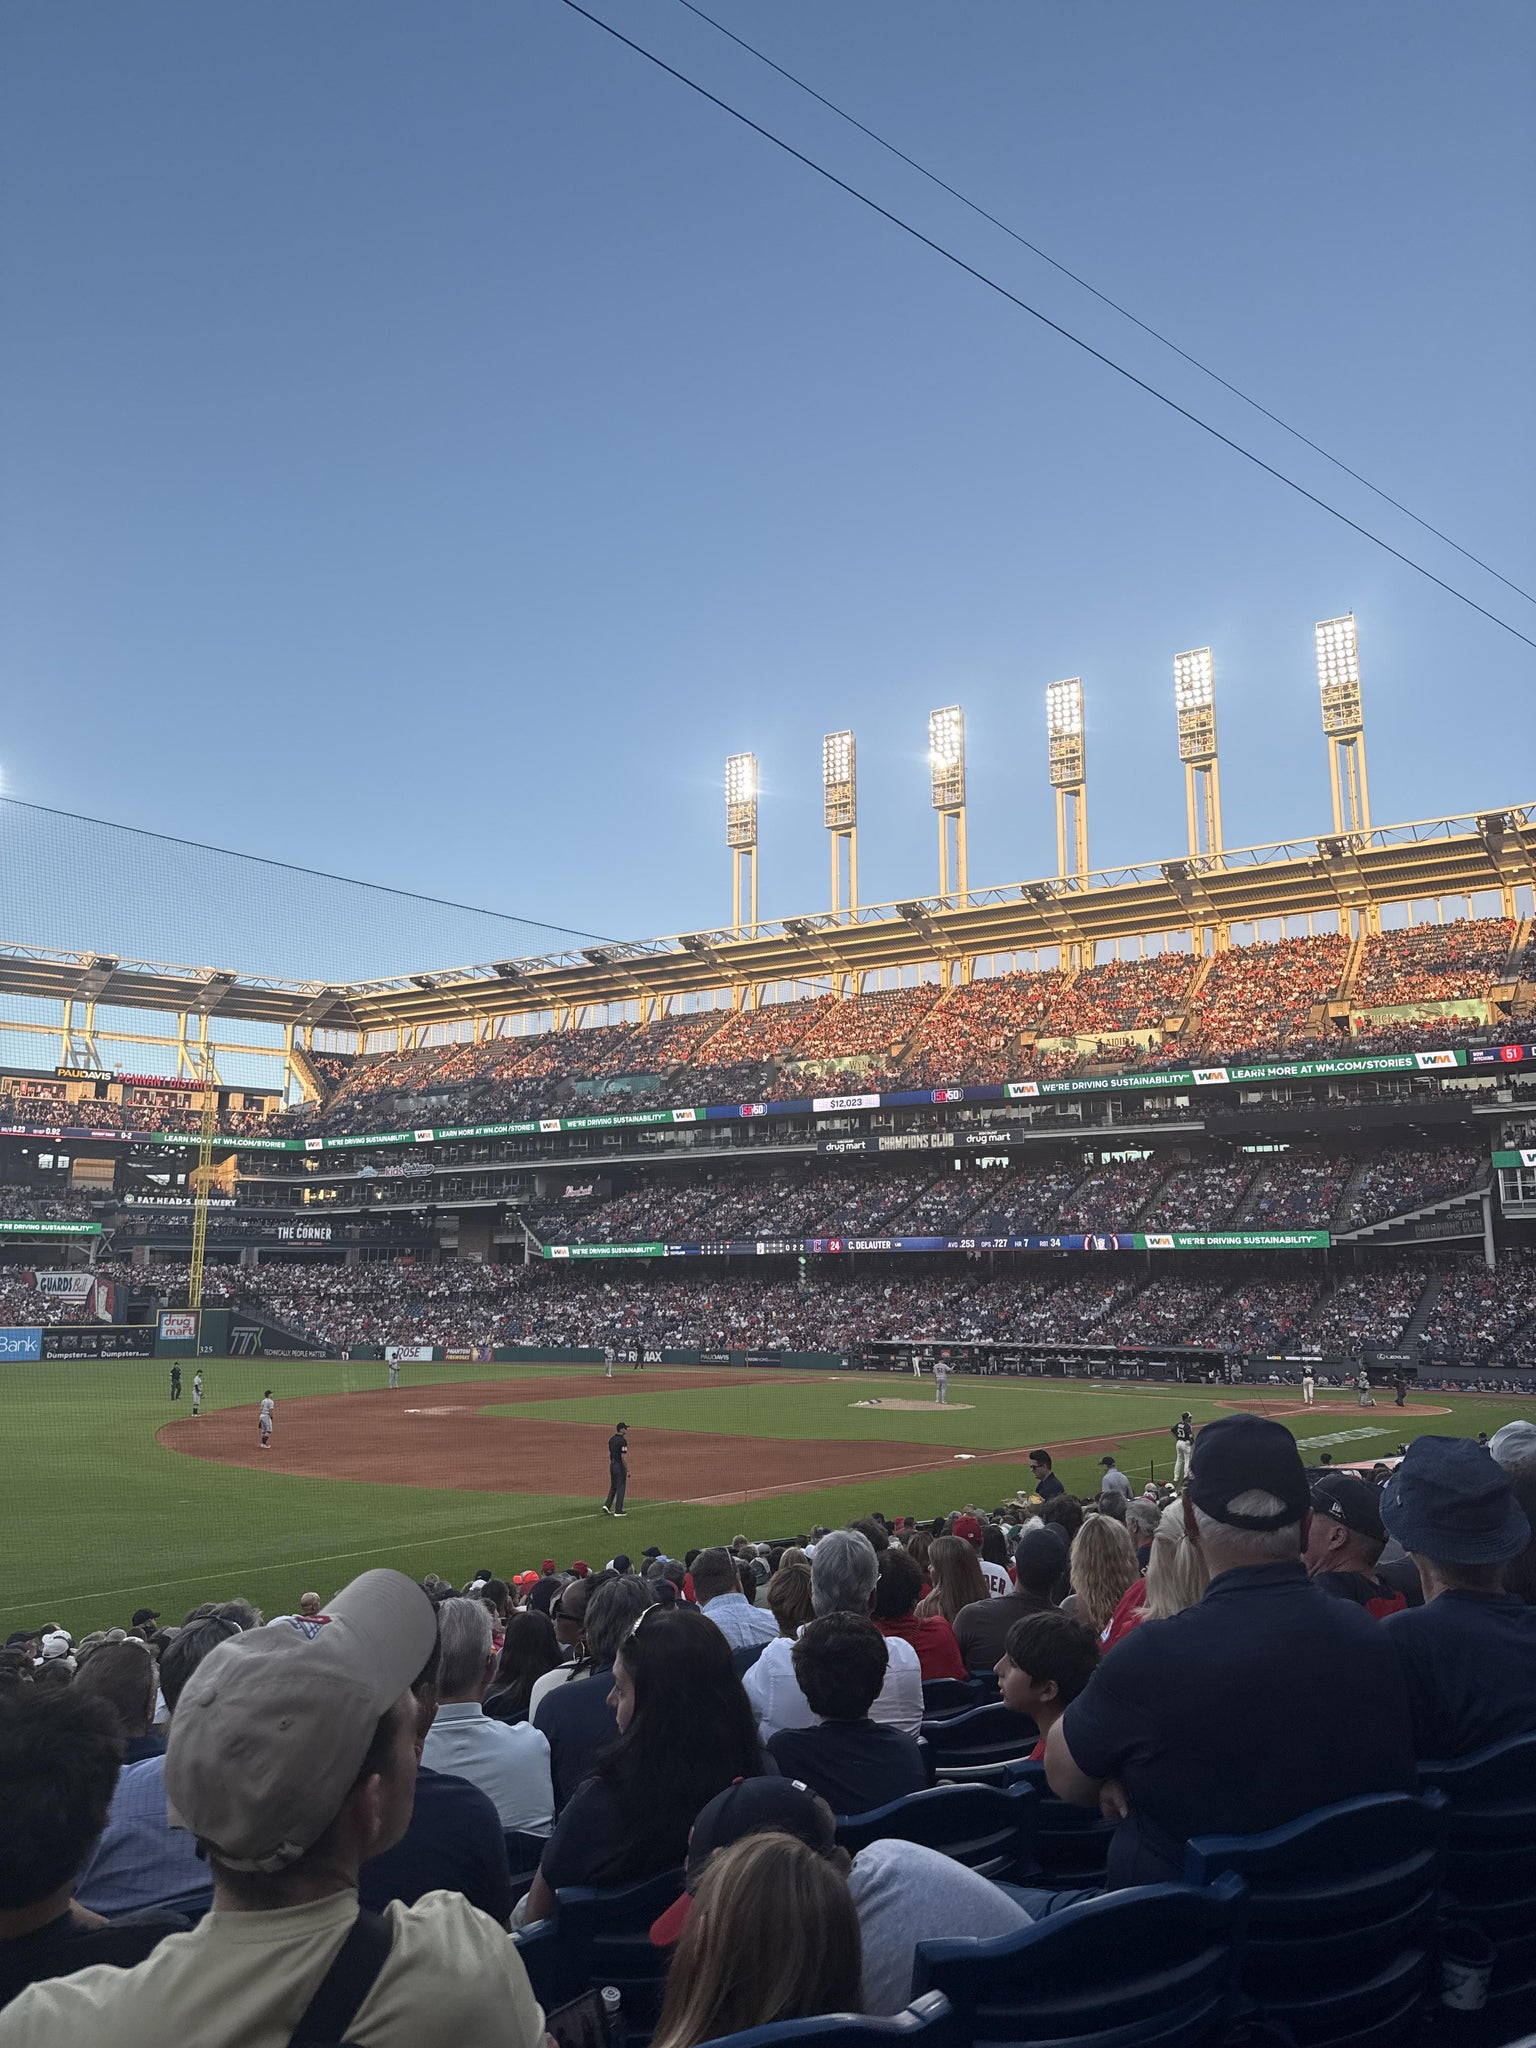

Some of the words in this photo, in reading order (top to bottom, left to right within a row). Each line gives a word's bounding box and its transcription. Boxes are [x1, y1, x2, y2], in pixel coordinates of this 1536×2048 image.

[1506, 1048, 1517, 1059] 51
[1422, 1055, 1450, 1064] WM
[1232, 1069, 1265, 1079] LEARN
[1267, 1067, 1297, 1076] MORE
[1300, 1065, 1313, 1074] AT
[1316, 1057, 1412, 1072] WM.COM/STORIES
[116, 1072, 168, 1087] PENNANT
[169, 1077, 206, 1090] DISTRI
[1199, 1072, 1223, 1081] WM
[1042, 1083, 1069, 1092] WE'RE
[1072, 1081, 1108, 1090] DRIVING
[830, 1098, 862, 1109] $12,023
[567, 1120, 586, 1128] WE'RE
[439, 1130, 457, 1138] LEARN
[458, 1128, 474, 1136] MORE
[966, 1134, 987, 1145] drug
[989, 1131, 1011, 1141] mart
[164, 1134, 188, 1143] LEARN
[345, 1137, 365, 1145] DRIVING
[879, 1135, 928, 1150] CHAMPIONS
[930, 1133, 954, 1147] CLUB
[826, 1143, 845, 1153] drug
[846, 1141, 866, 1149] mart
[385, 1165, 403, 1177] kids
[137, 1196, 154, 1204] FAT
[156, 1197, 191, 1206] HEAD'S
[1446, 1210, 1463, 1220] drug
[1463, 1209, 1481, 1218] mart
[14, 1223, 40, 1231] DRIVING
[278, 1226, 295, 1240] THE
[296, 1226, 332, 1240] CORNER
[830, 1241, 840, 1251] 24
[856, 1240, 891, 1250] DELAUTER
[959, 1239, 975, 1248] .253
[992, 1239, 1008, 1248] .727
[1024, 1238, 1029, 1247] 7
[1050, 1238, 1061, 1247] 34
[1150, 1237, 1171, 1245] WM
[1179, 1237, 1205, 1245] WE'RE
[1207, 1237, 1242, 1245] DRIVING
[572, 1247, 589, 1255] WE'RE
[792, 1243, 798, 1251] 2
[800, 1243, 805, 1251] 2
[40, 1277, 72, 1292] GUARDS
[164, 1315, 191, 1328] drug
[165, 1327, 195, 1337] mart
[200, 1345, 213, 1353] 325
[292, 1349, 308, 1357] PEOPLE
